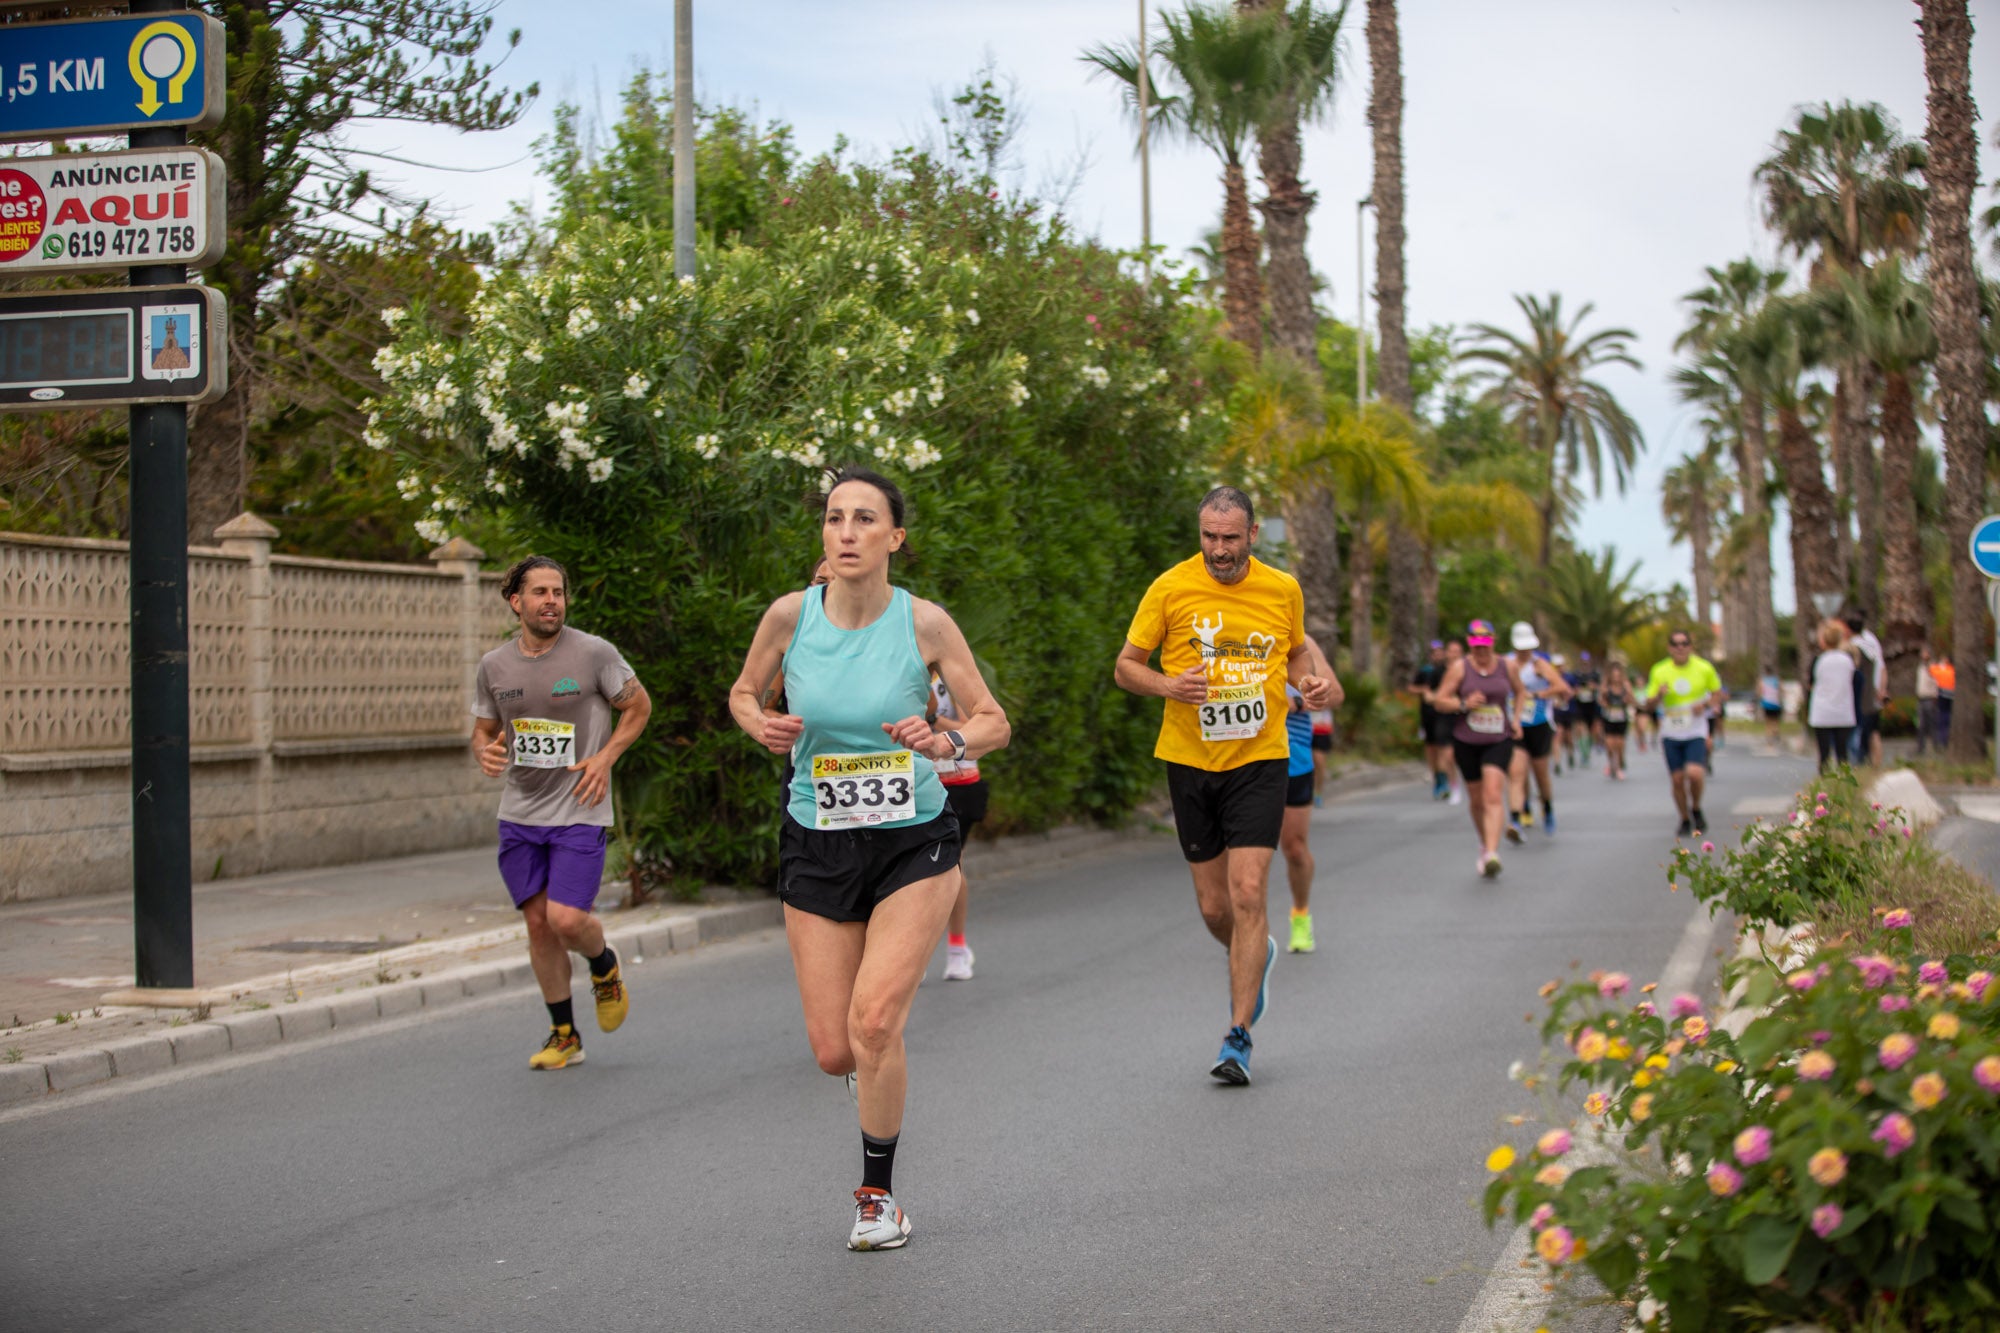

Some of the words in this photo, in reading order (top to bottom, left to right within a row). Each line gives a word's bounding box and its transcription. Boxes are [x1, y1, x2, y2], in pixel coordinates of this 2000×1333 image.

[48, 57, 105, 93] KM
[50, 162, 196, 188] ANÚNCIATE
[0, 195, 43, 219] es?
[52, 183, 192, 226] AQUÍ
[68, 230, 106, 258] 619
[112, 228, 150, 255] 472
[156, 226, 195, 253] 758
[1202, 701, 1264, 726] 3100
[516, 735, 572, 755] 3337
[823, 759, 839, 772] 38
[838, 759, 891, 772] FONDO
[818, 777, 910, 810] 3333
